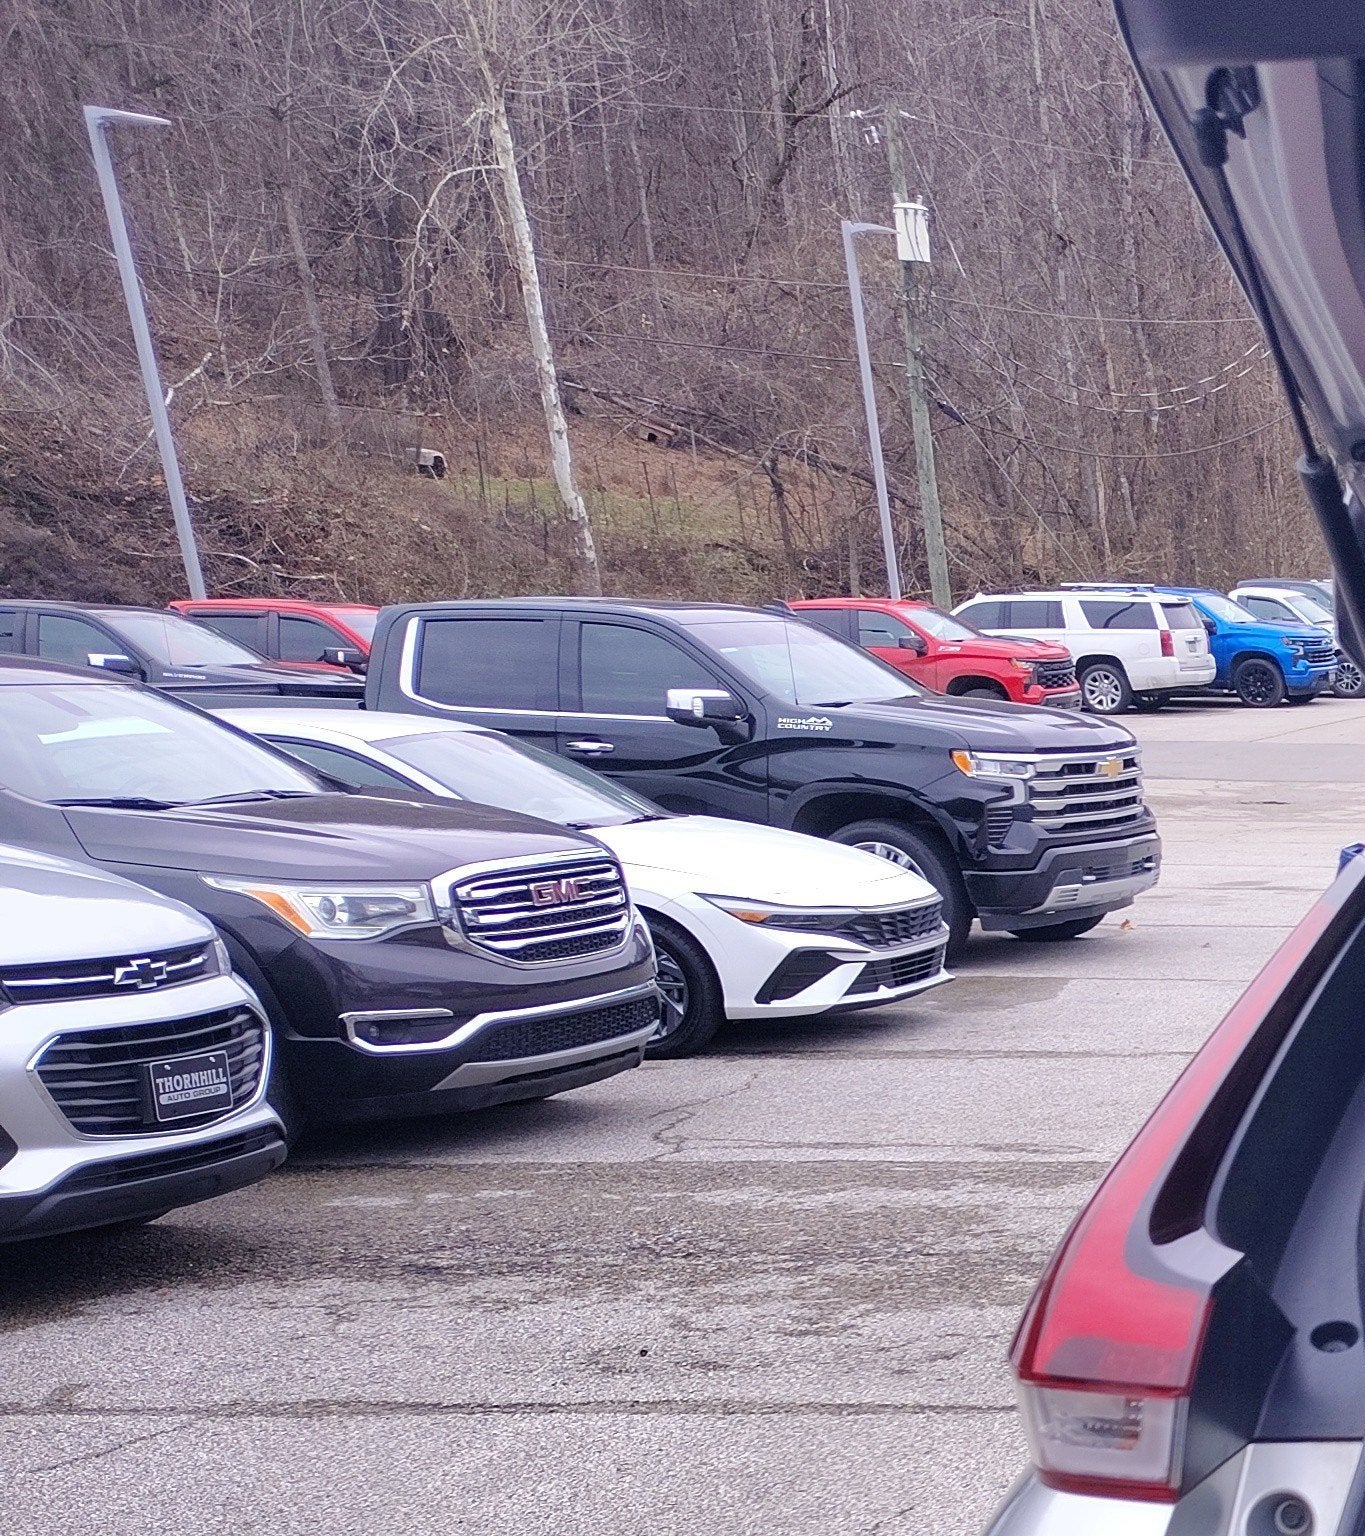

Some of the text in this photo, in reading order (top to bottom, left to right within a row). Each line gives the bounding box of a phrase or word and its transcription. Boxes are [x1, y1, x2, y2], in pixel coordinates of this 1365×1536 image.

[777, 723, 832, 731] COUNTRY
[530, 878, 595, 906] GMC
[156, 1067, 227, 1093] THORNHILL
[167, 1086, 221, 1102] AUTO GROUP
